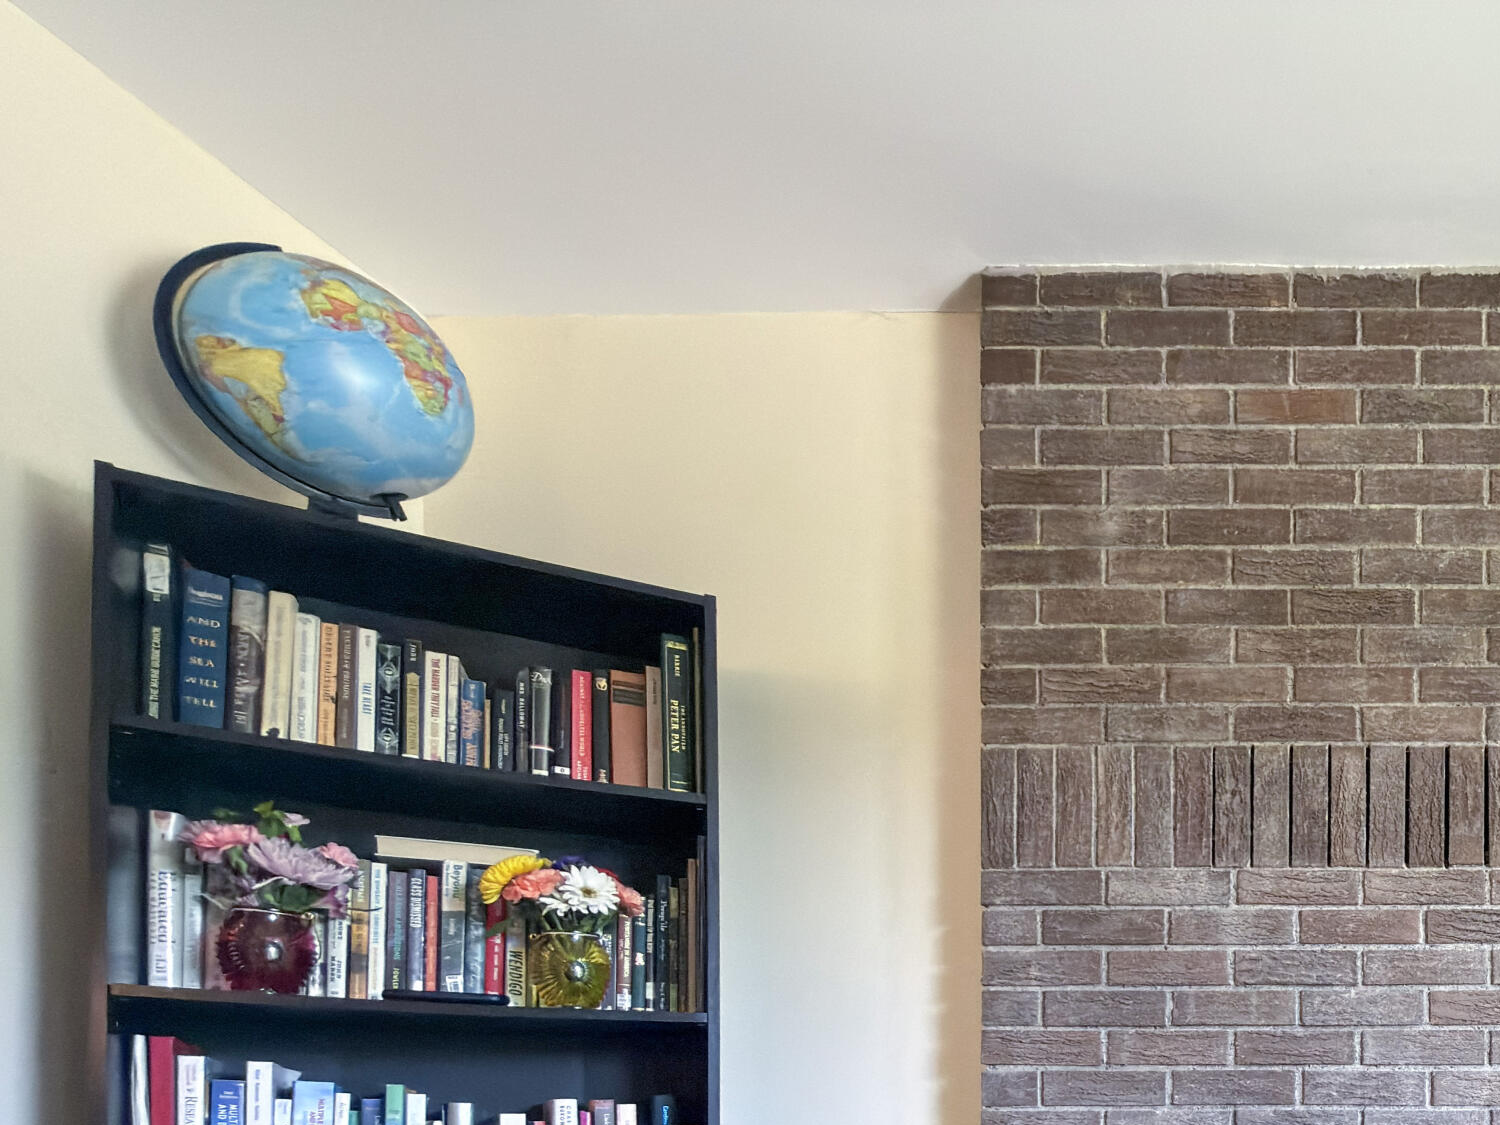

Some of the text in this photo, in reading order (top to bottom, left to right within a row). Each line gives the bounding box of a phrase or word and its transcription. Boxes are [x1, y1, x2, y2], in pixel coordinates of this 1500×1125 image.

[187, 616, 221, 628] AND
[188, 636, 216, 648] THE
[324, 627, 333, 657] DESERT
[189, 656, 215, 667] SEA
[185, 676, 219, 688] WILL
[183, 695, 217, 708] TELL
[670, 699, 680, 753] PETER PAN
[158, 871, 176, 944] Educated
[410, 877, 422, 927] CLASS DISMISSED
[508, 949, 524, 996] WENDIGO
[218, 1104, 227, 1119] AND
[316, 1099, 324, 1124] MULTIPLE
